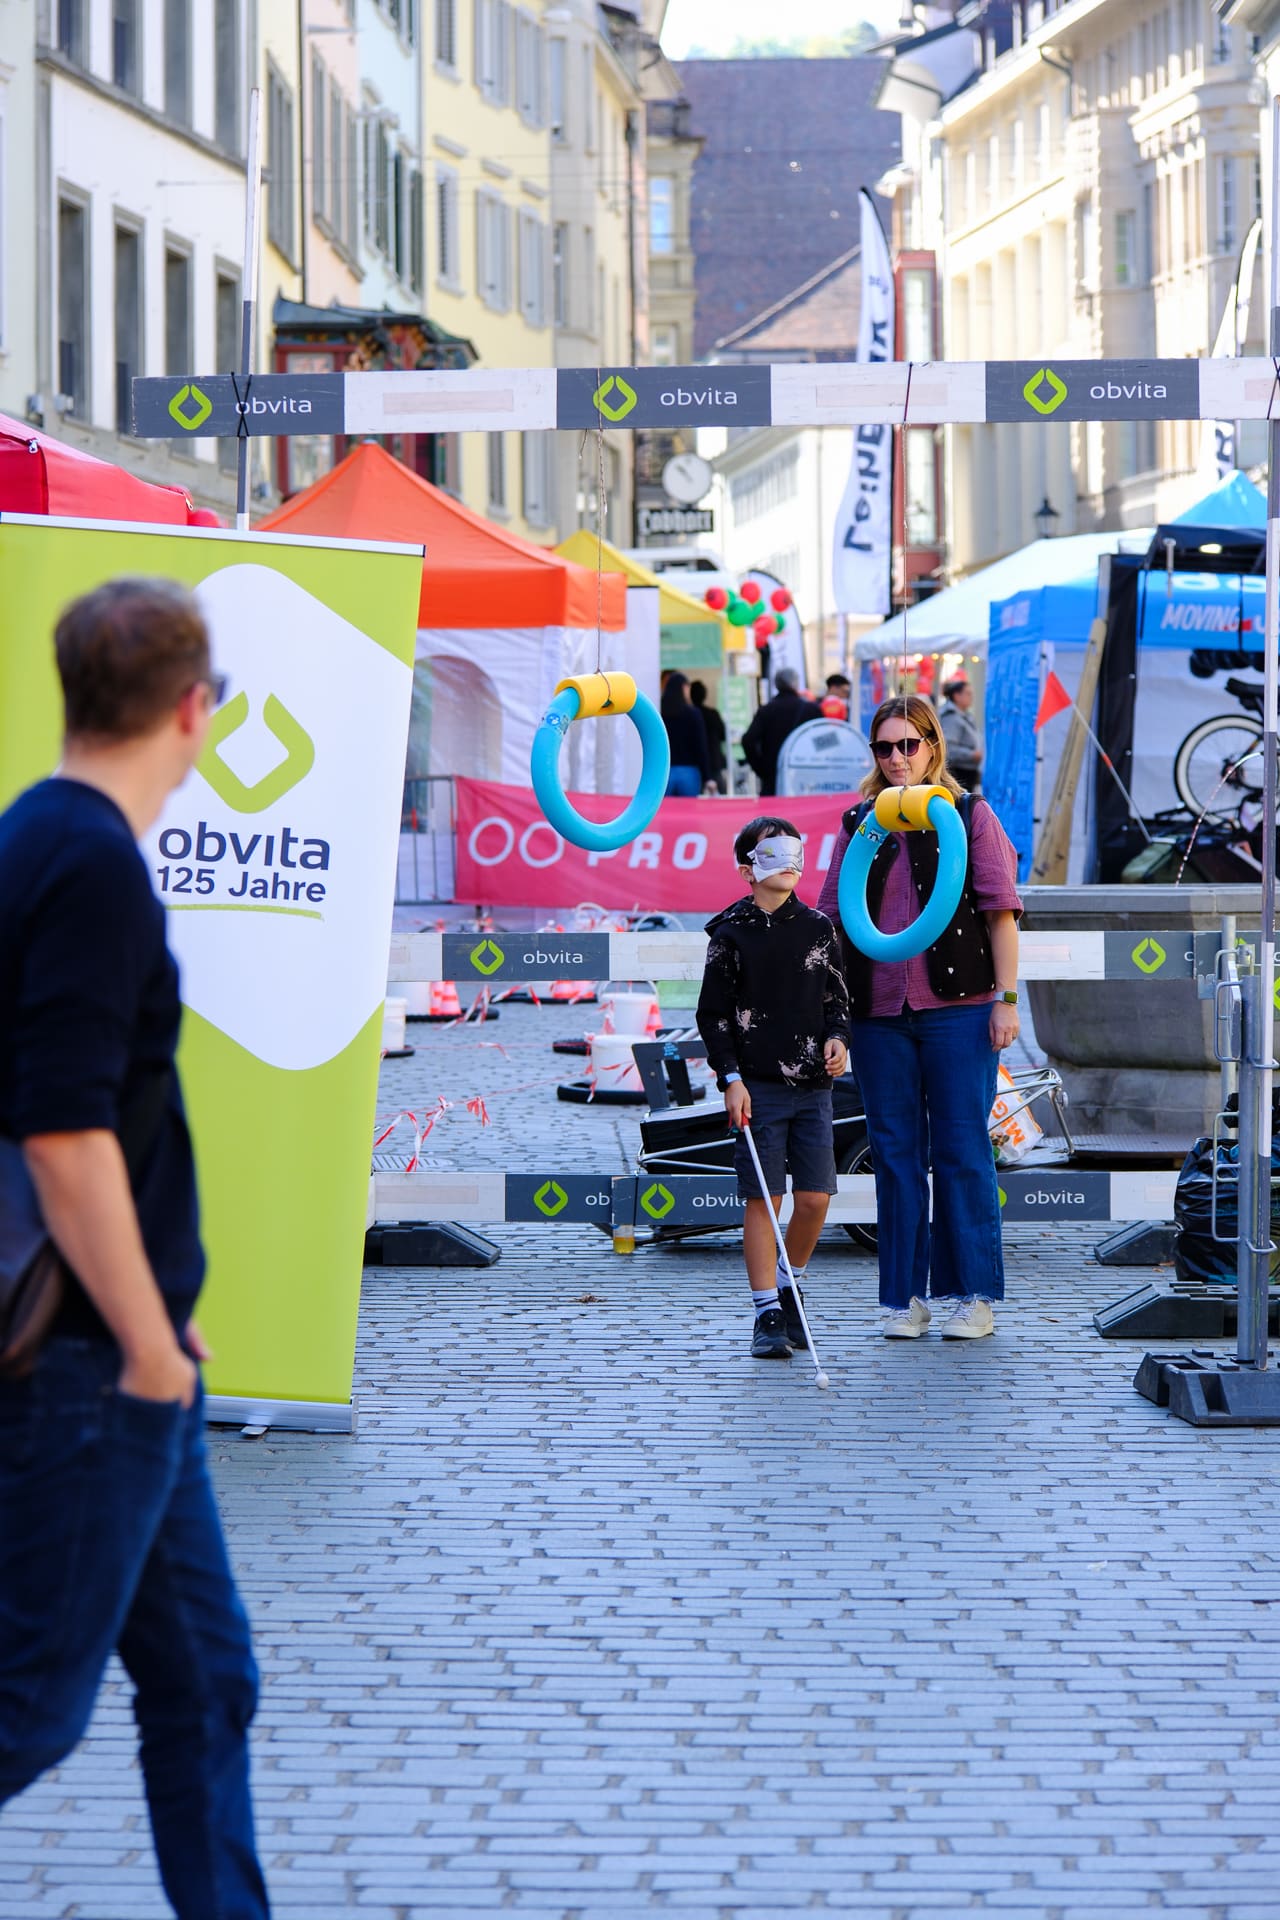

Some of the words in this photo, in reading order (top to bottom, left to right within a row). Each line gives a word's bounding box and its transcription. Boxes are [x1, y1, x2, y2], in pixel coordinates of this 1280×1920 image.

[660, 387, 738, 406] obvita
[1090, 380, 1167, 399] obvita
[235, 395, 312, 415] obvita
[158, 821, 331, 871] obvita
[157, 866, 216, 895] 125
[228, 871, 327, 903] Jahre
[523, 949, 583, 964] obvita
[991, 1094, 1025, 1147] MIG
[1024, 1189, 1085, 1205] obvita
